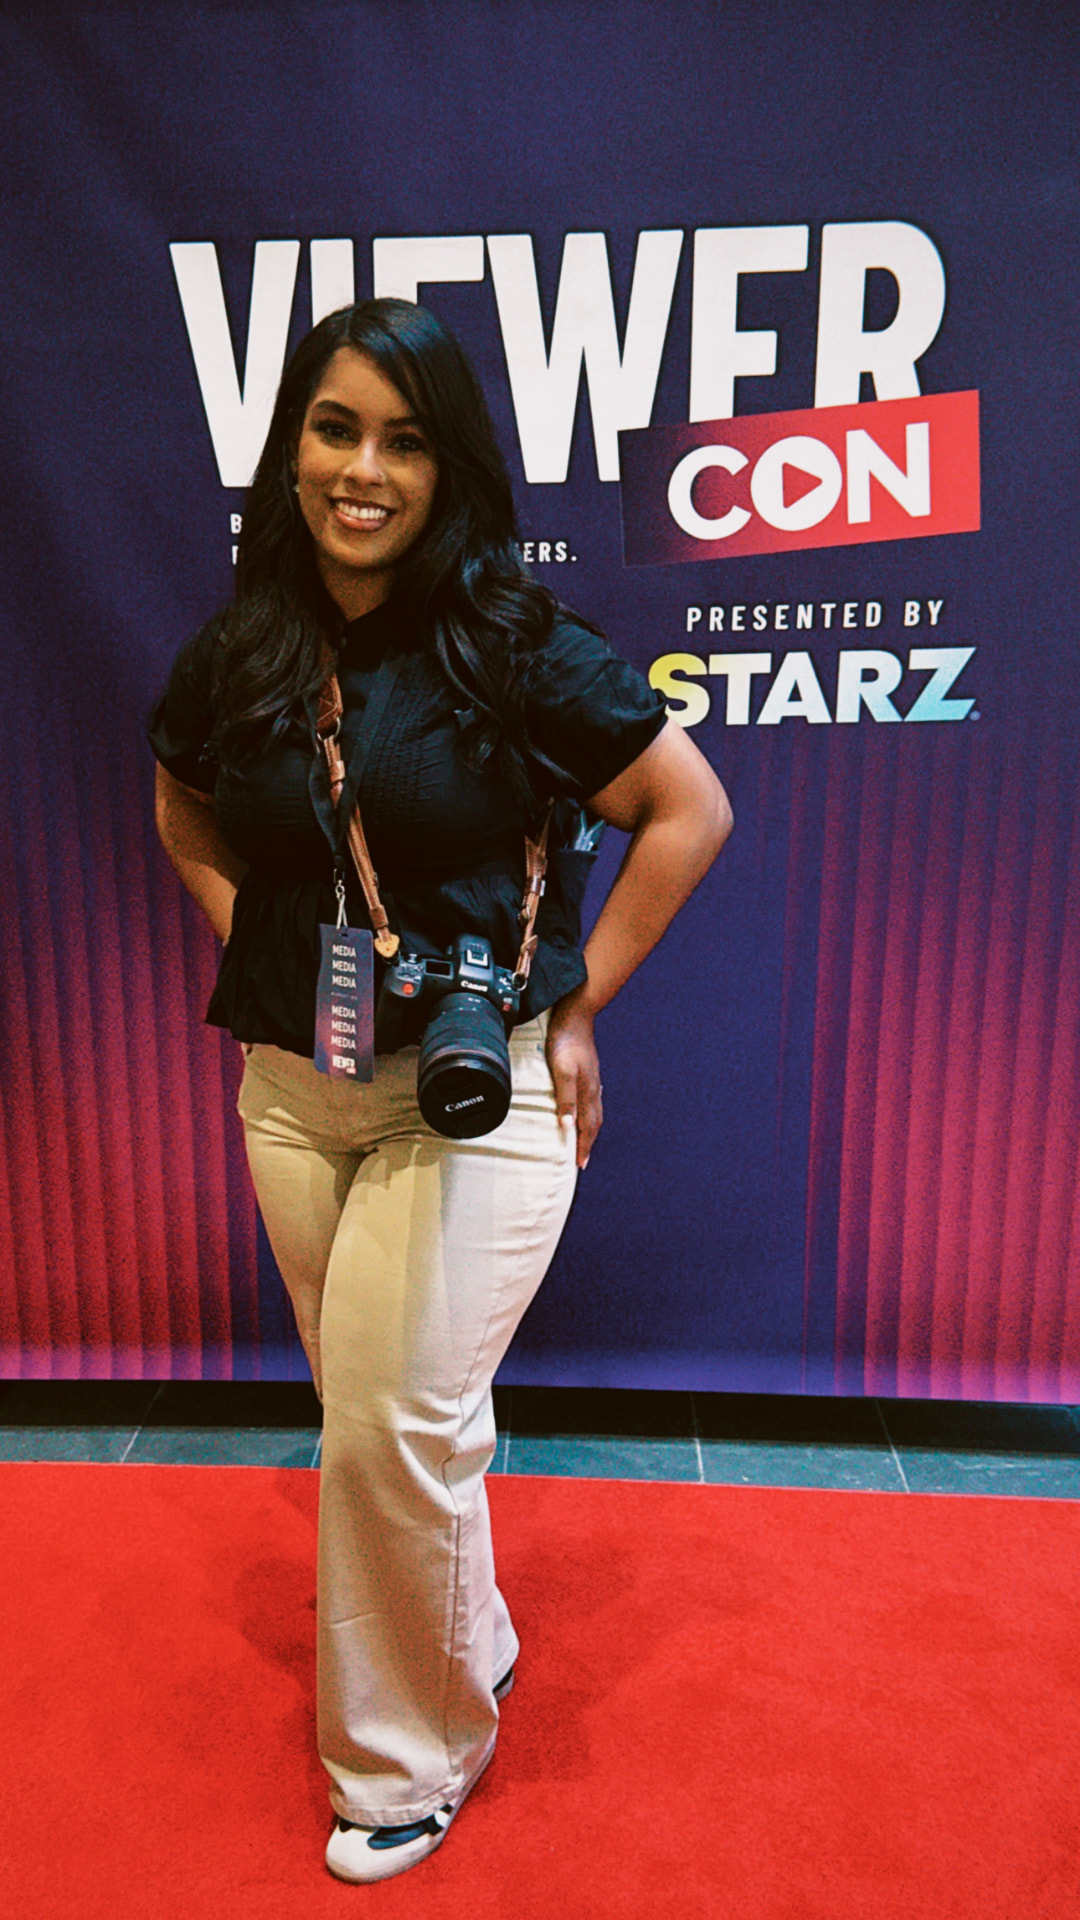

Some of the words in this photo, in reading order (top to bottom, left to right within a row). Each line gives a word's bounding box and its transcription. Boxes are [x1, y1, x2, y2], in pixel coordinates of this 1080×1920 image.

[667, 422, 932, 541] CON
[686, 601, 882, 632] PRESENTED
[904, 599, 944, 626] BY
[648, 646, 978, 728] STARZ
[332, 944, 357, 958] MEDIA
[332, 959, 357, 973] MEDIA
[332, 974, 356, 989] MEDIA
[461, 980, 488, 992] Canon
[331, 1005, 356, 1019] MEDIA
[331, 1020, 356, 1035] MEDIA
[331, 1035, 356, 1049] MEDIA
[445, 1095, 484, 1112] Canon
